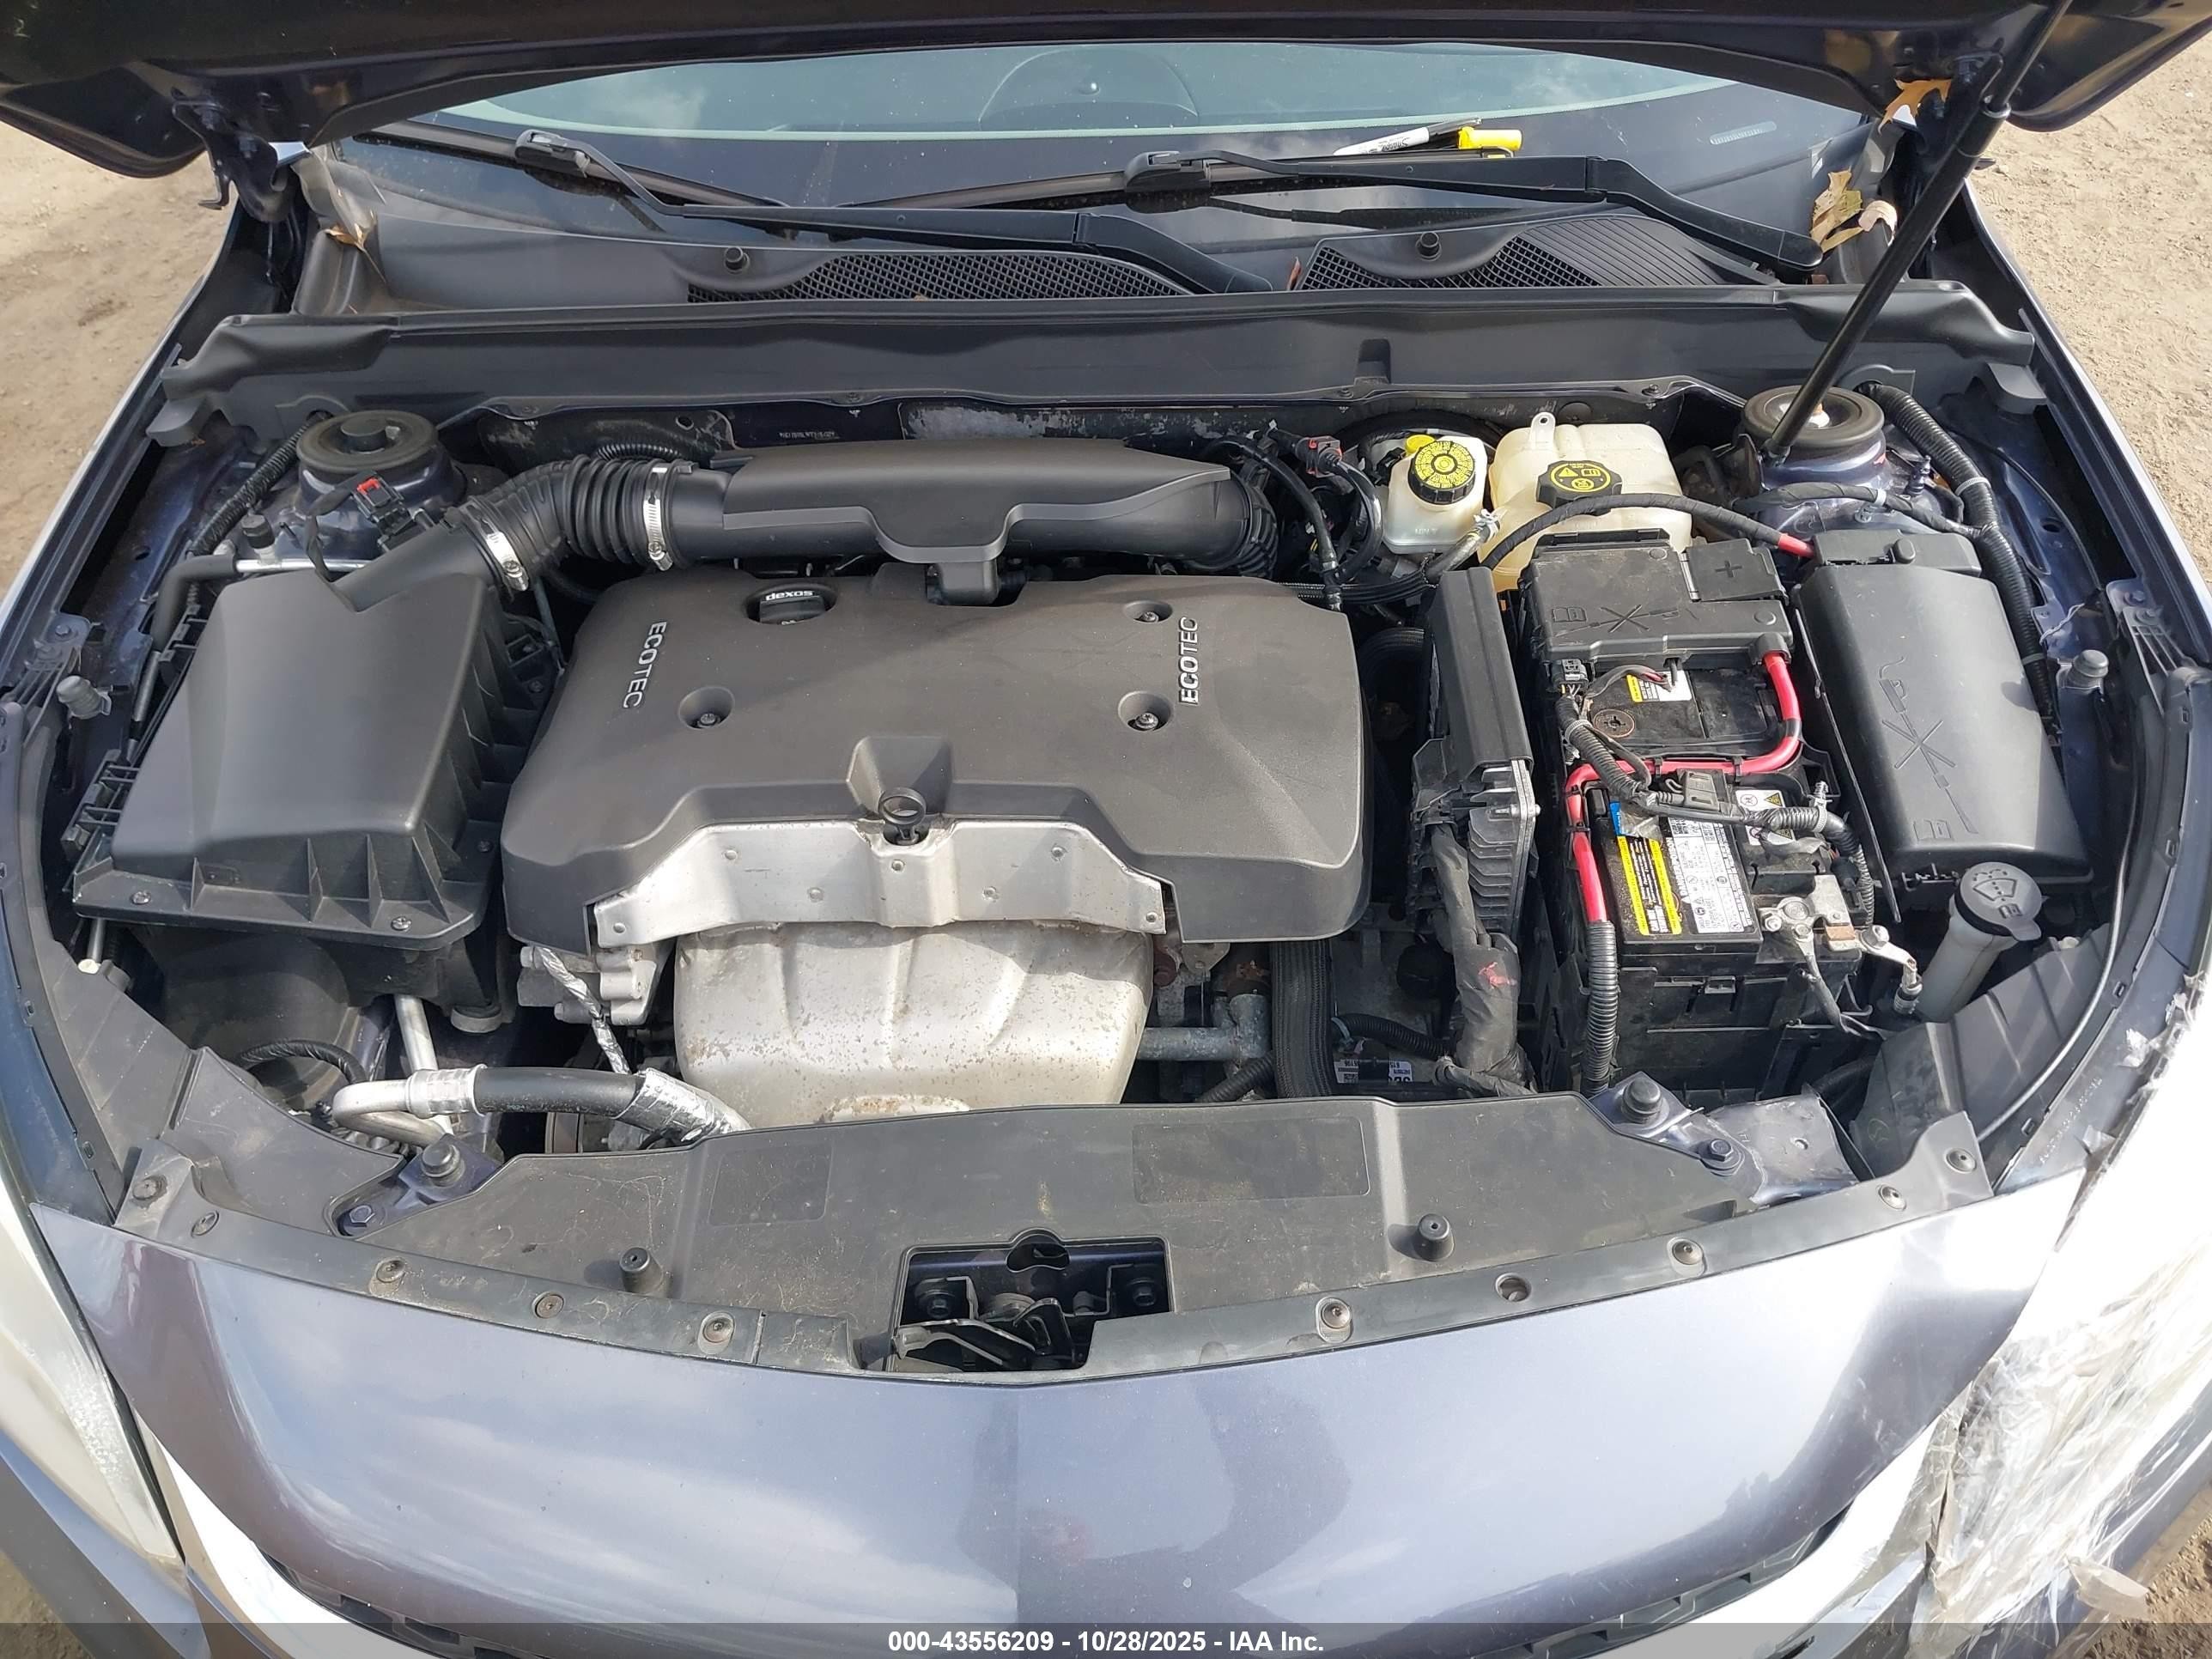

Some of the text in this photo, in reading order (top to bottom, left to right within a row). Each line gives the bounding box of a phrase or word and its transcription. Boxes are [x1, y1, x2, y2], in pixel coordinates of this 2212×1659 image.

[765, 590, 814, 601] dexos
[623, 622, 666, 708] ECOTEC
[1180, 617, 1199, 704] ECOTEC
